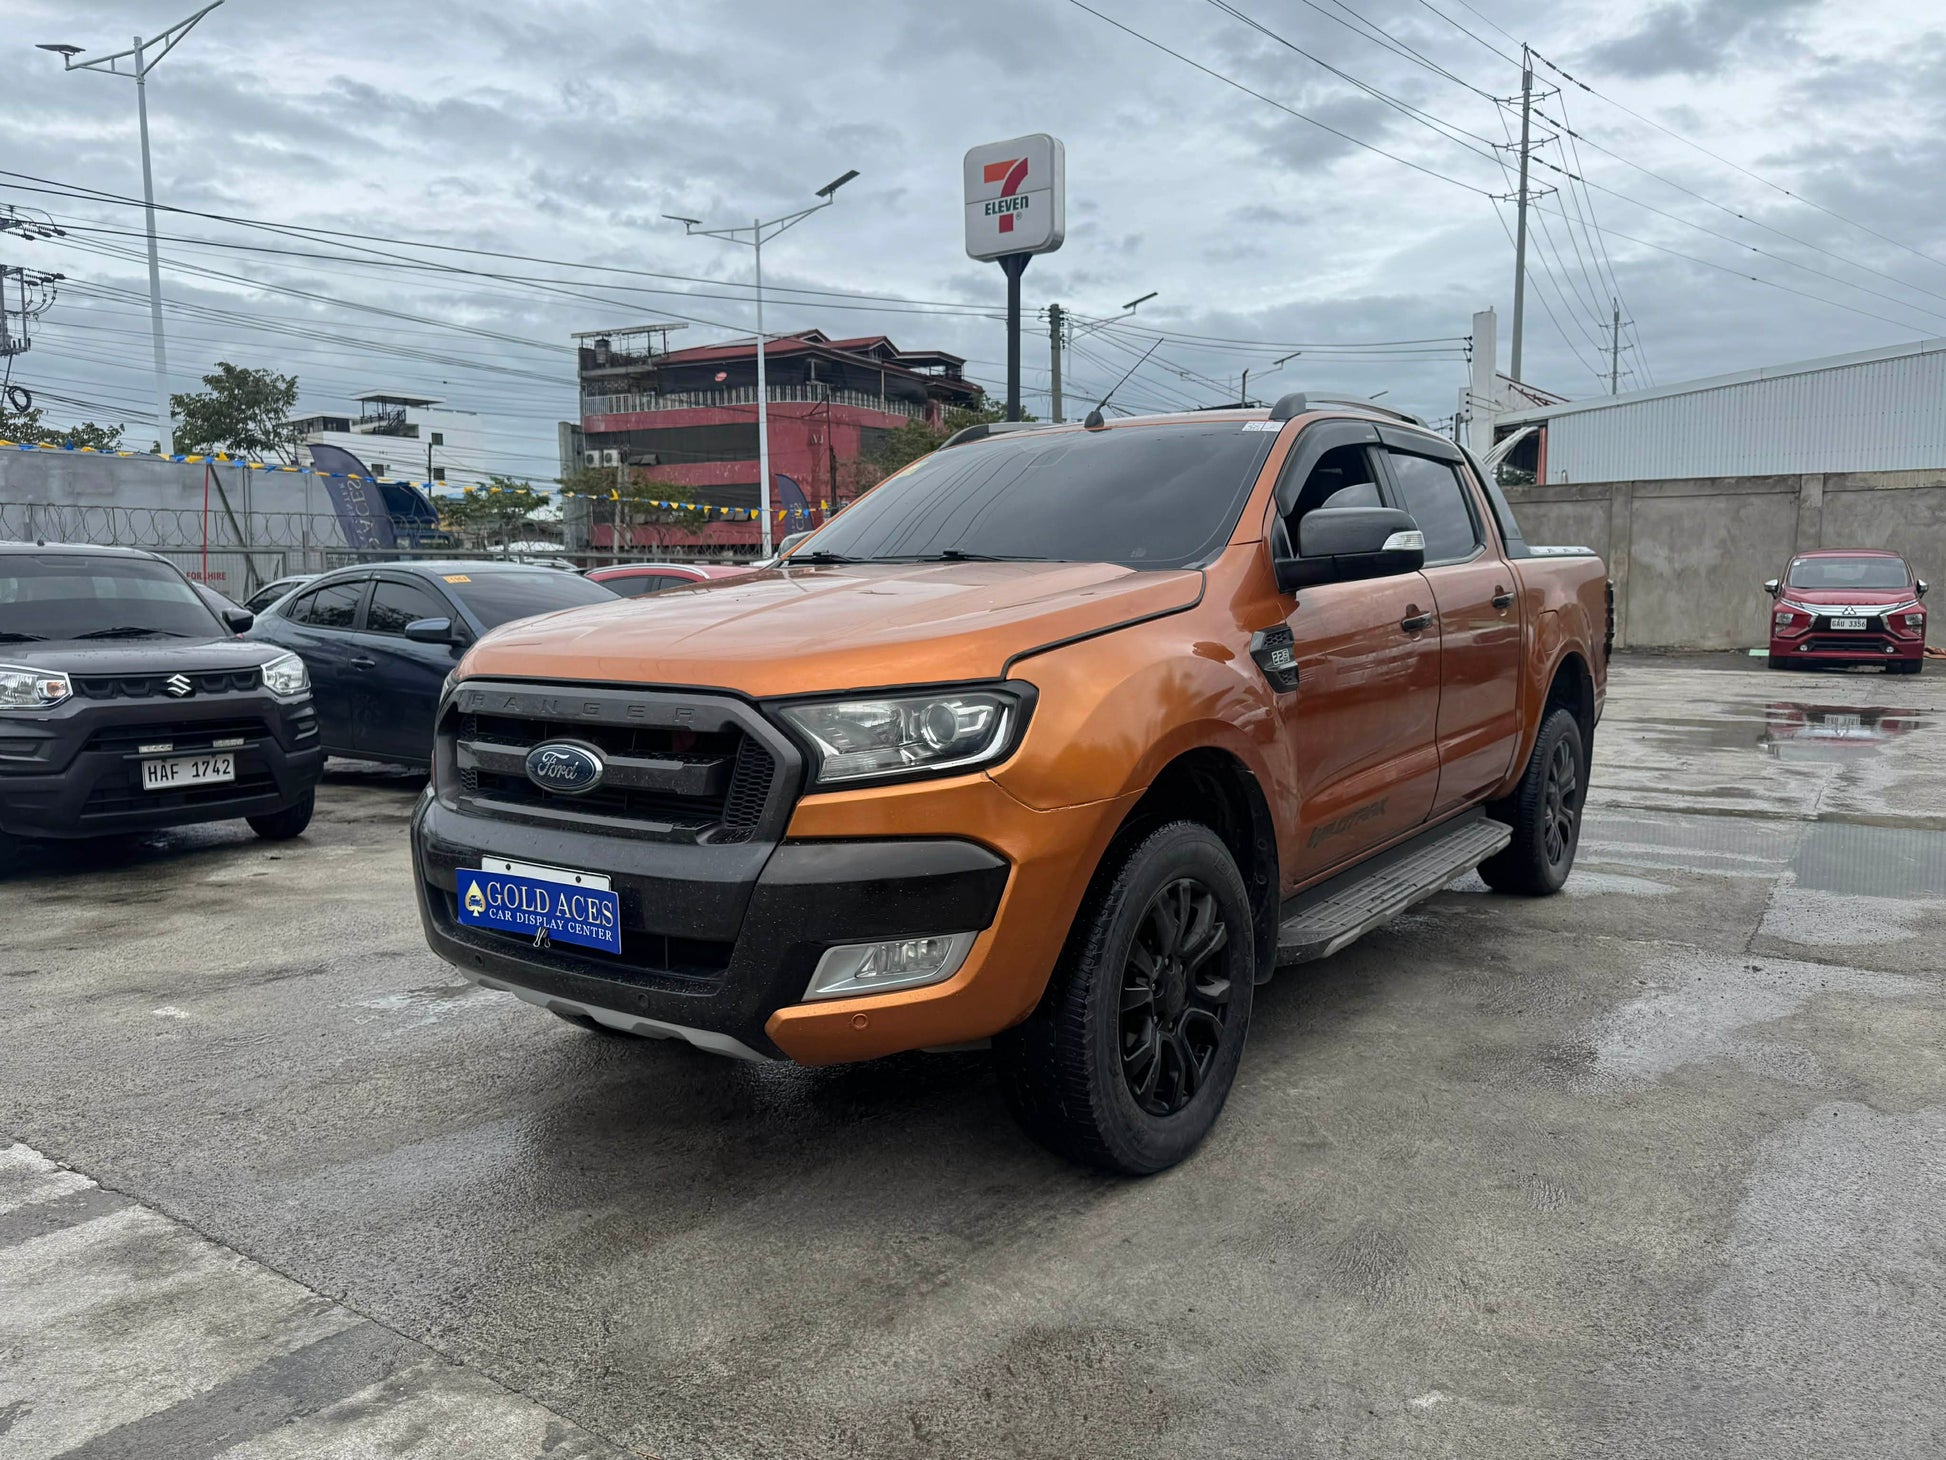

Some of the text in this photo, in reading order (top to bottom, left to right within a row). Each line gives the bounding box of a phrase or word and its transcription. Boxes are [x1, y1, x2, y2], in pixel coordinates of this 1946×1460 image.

[984, 157, 1028, 233] 7
[186, 571, 227, 580] FOR HIRE
[470, 694, 695, 722] RANGER
[148, 759, 230, 782] HAF 1742
[537, 751, 579, 780] Ford
[486, 881, 614, 927] GOLD ACES
[489, 908, 613, 942] CAR DISPLAY CENTER
